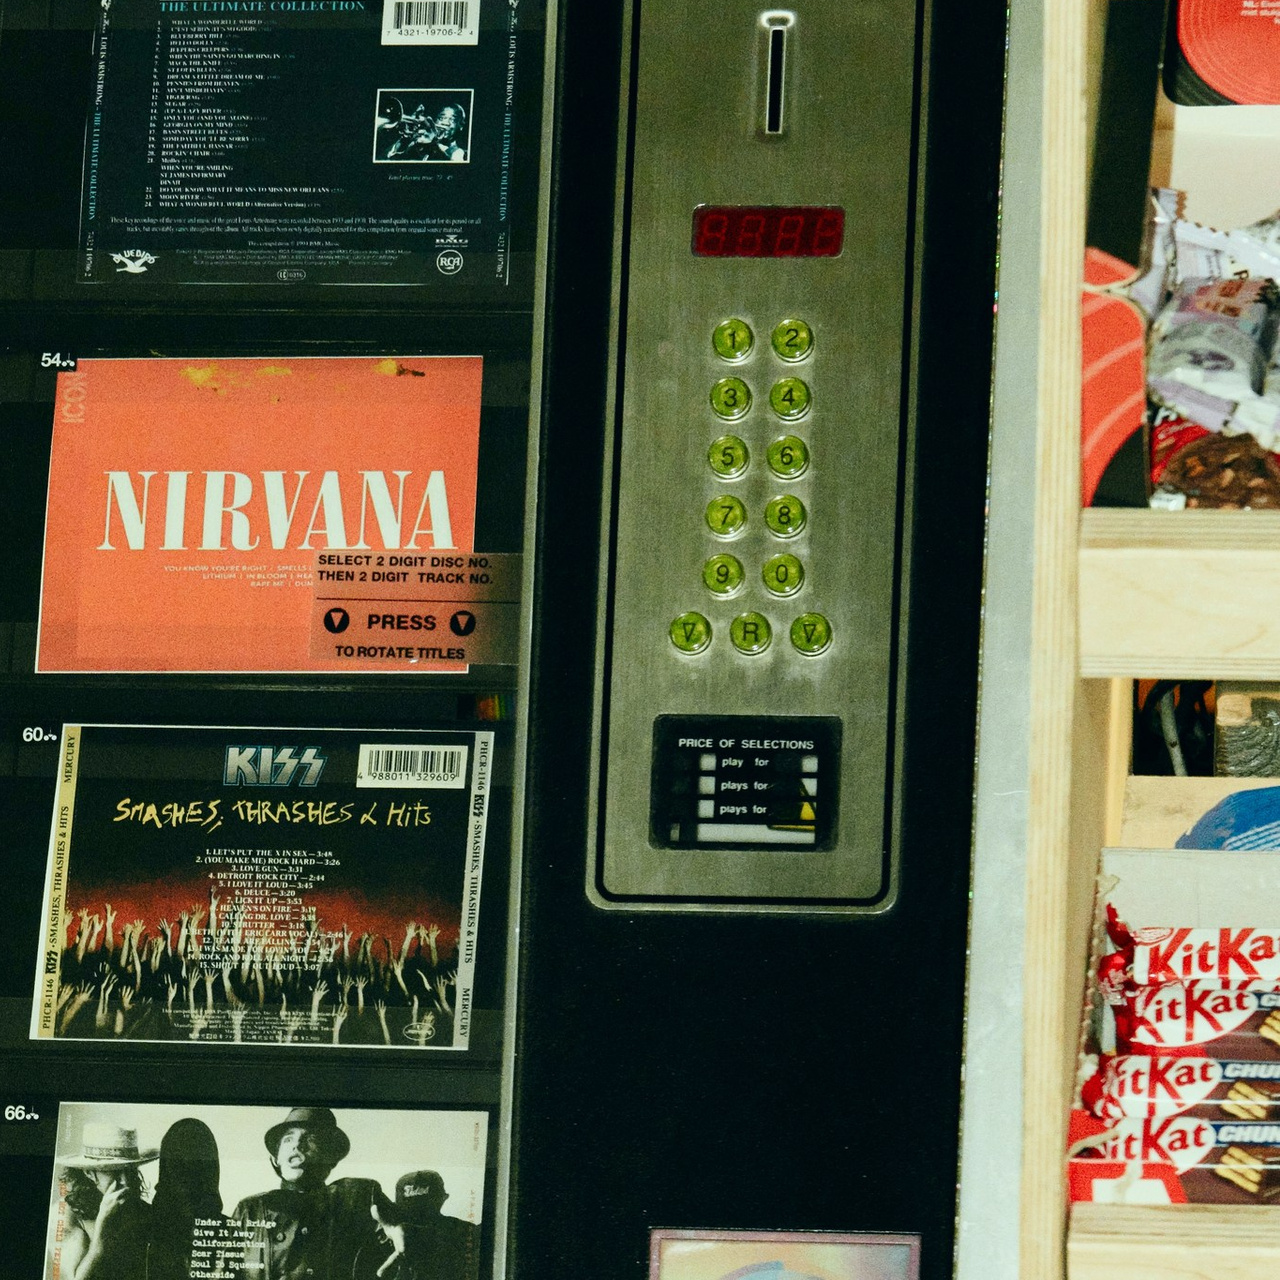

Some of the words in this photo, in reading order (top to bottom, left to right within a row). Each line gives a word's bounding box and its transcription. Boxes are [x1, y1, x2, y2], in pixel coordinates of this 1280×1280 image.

[160, 2, 188, 12] THE
[192, 2, 266, 12] ULTIMATE
[270, 2, 365, 12] COLLECTION
[729, 331, 737, 350] 1
[785, 328, 800, 348] 2
[40, 352, 61, 368] 54
[62, 372, 87, 423] ICON
[724, 388, 738, 408] 3
[781, 388, 796, 406] 4
[721, 447, 736, 467] 5
[780, 446, 794, 466] 6
[96, 470, 458, 551] NIRVANA
[721, 506, 734, 526] 7
[778, 505, 791, 525] 8
[318, 554, 372, 566] SELECT
[376, 555, 385, 567] 2
[389, 555, 427, 567] DIGIT
[430, 556, 465, 569] DISC
[467, 556, 493, 568] NO.
[317, 570, 355, 582] THEN
[359, 571, 367, 582] 2
[371, 571, 409, 583] DIGIT
[417, 572, 466, 584] TRACK
[469, 573, 494, 585] NO.
[716, 564, 729, 584] 9
[776, 564, 789, 584] 0
[367, 614, 437, 631] PRESS
[743, 622, 759, 643] R
[335, 645, 355, 658] TO
[356, 647, 416, 660] ROTATE
[416, 647, 466, 661] TITLES
[22, 727, 43, 742] 60
[678, 738, 713, 748] PRICE
[718, 738, 735, 749] OF
[741, 739, 814, 750] SELECTIONS
[222, 745, 328, 787] KISS
[721, 757, 744, 768] play
[754, 757, 770, 767] for
[720, 780, 749, 792] plays
[753, 781, 769, 791] for
[232, 799, 355, 826] THRASHES
[719, 805, 748, 816] plays
[752, 804, 767, 814] for
[1147, 928, 1280, 984] KitKa
[1116, 1056, 1214, 1118] itKat
[4, 1106, 25, 1121] 66
[1110, 1118, 1208, 1161] itKat
[193, 1229, 215, 1237] Give
[219, 1229, 229, 1237] It
[233, 1230, 255, 1239] Away
